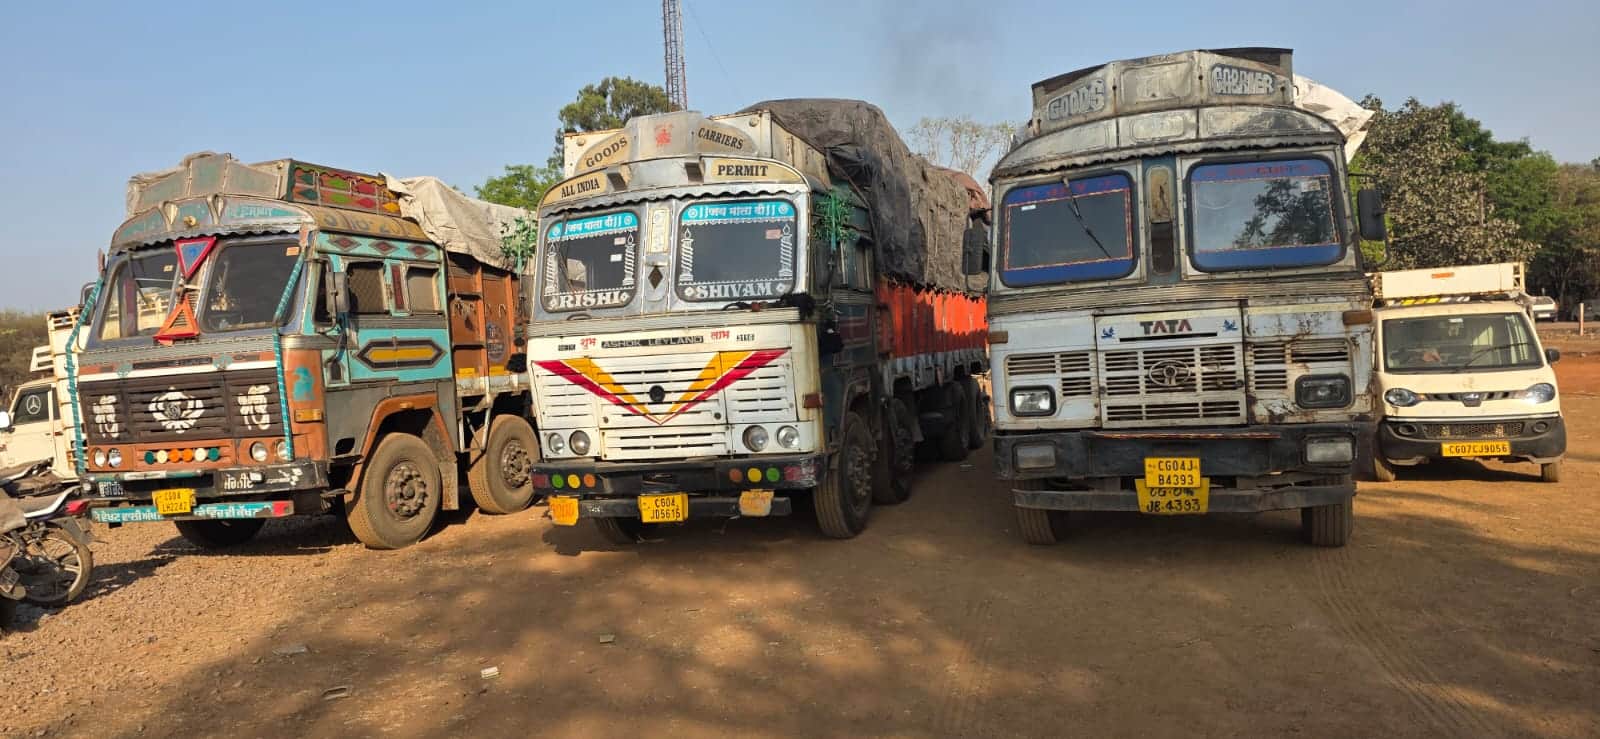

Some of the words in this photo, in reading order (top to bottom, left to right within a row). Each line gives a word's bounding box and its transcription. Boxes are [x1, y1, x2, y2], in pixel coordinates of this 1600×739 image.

[1048, 79, 1105, 120] GOODS
[586, 136, 628, 168] GOODS
[697, 127, 744, 150] CARRIERS
[560, 184, 577, 198] ALL
[577, 178, 600, 195] INDIA
[717, 164, 769, 177] PERMIT
[695, 282, 774, 299] SHIVAM
[559, 290, 620, 309] RISHI
[1139, 319, 1193, 336] TATA
[602, 339, 641, 349] ASHOK
[649, 336, 704, 346] LEYLAND
[1448, 444, 1508, 455] CG07CJ9056
[1158, 460, 1194, 472] CG04J
[1158, 474, 1194, 486] B4393
[654, 498, 675, 508] CG04
